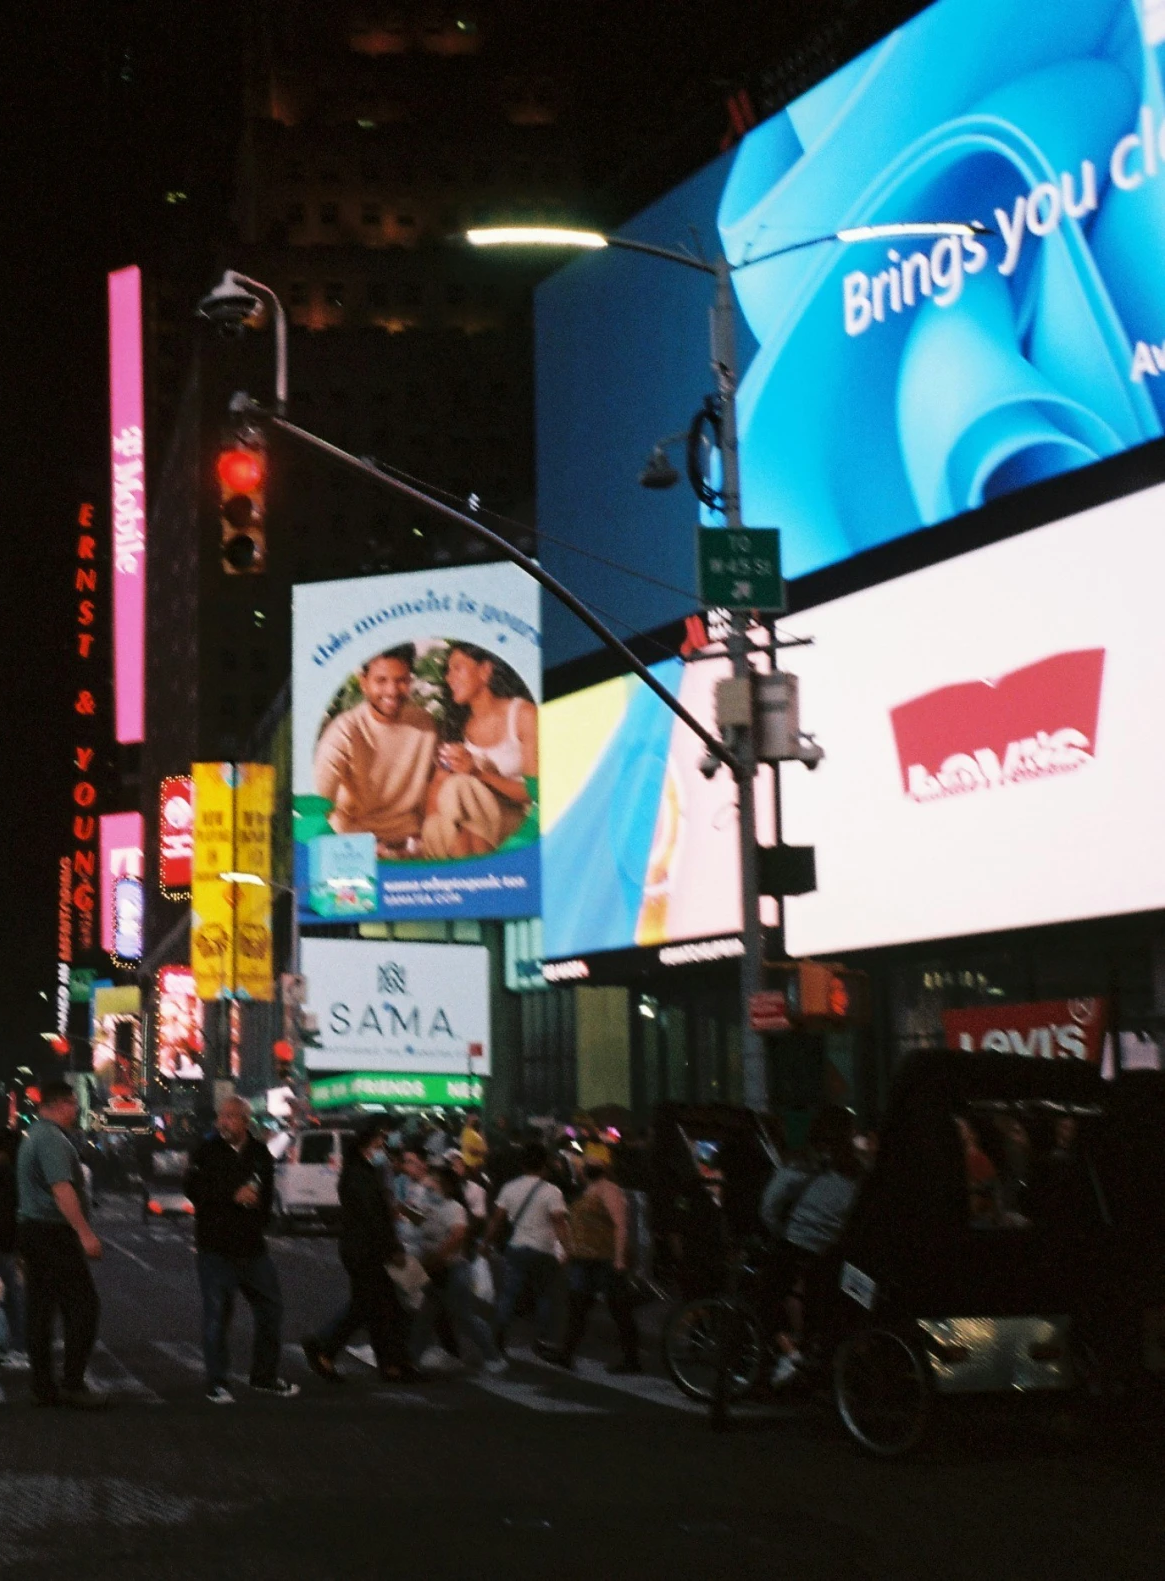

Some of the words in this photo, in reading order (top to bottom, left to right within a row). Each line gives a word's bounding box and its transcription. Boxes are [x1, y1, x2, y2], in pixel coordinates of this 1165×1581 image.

[843, 233, 987, 336] Brings
[994, 160, 1097, 276] you
[1110, 105, 1165, 190] cl
[74, 502, 98, 658] ERNST
[74, 691, 95, 716] &
[72, 747, 96, 912] YOUNG
[329, 1003, 456, 1039] SAMA
